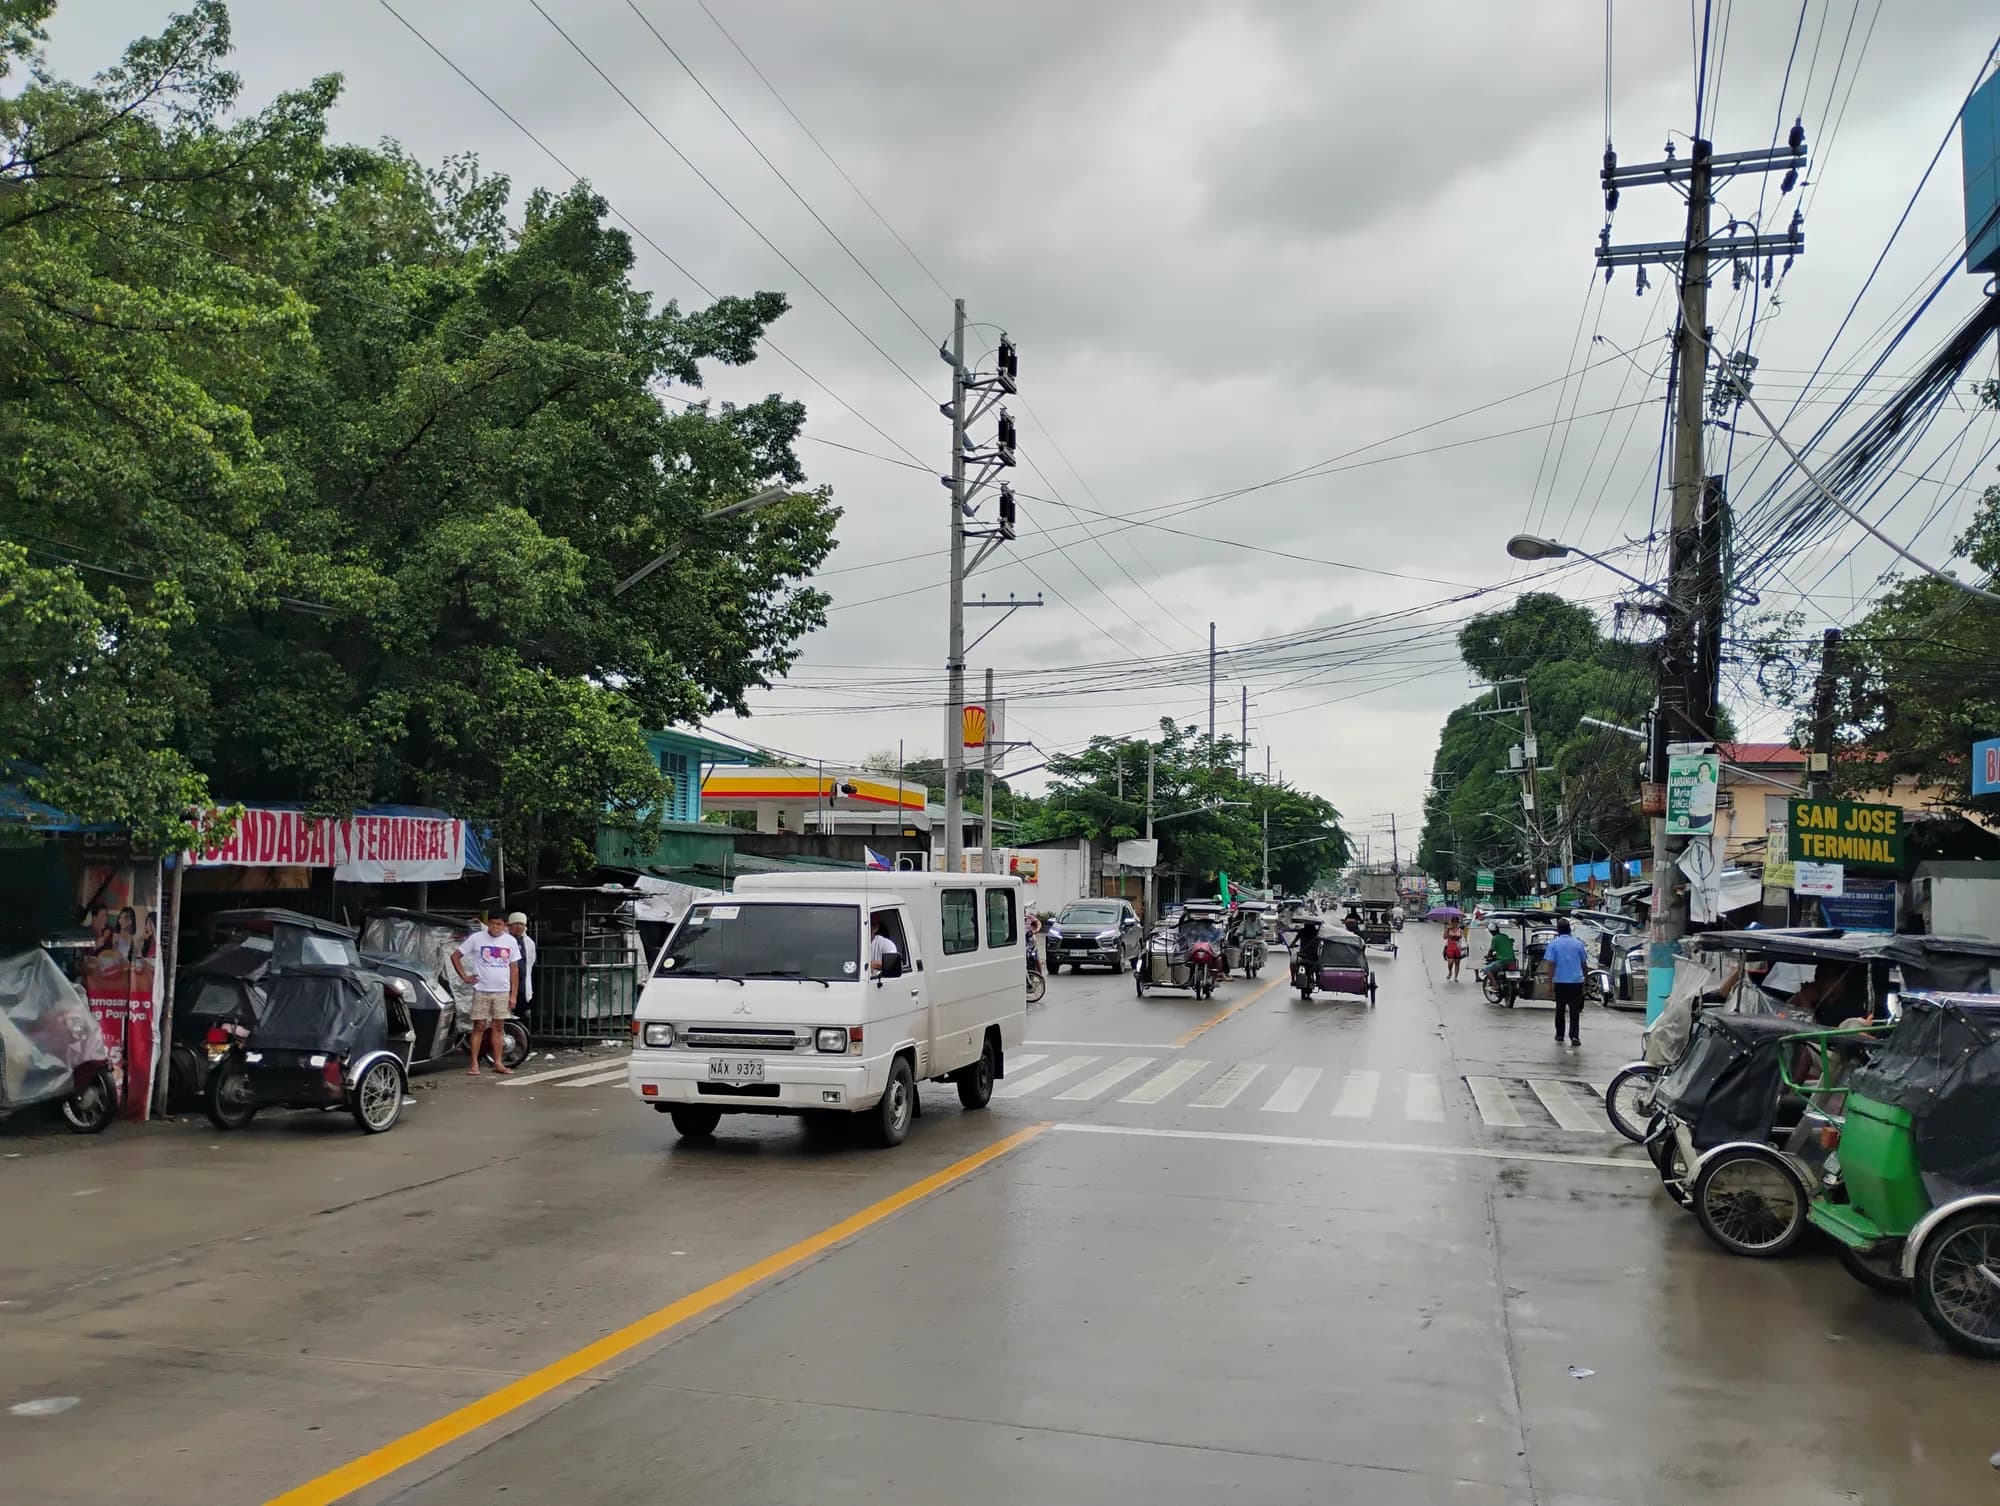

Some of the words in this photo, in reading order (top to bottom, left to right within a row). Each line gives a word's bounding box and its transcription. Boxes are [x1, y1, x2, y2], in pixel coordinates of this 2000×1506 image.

[1796, 804, 1838, 830] SAN
[1844, 808, 1897, 835] JOSE
[356, 816, 449, 861] TERMINAL
[1800, 833, 1896, 863] TERMINAL
[710, 1062, 730, 1075] NAX
